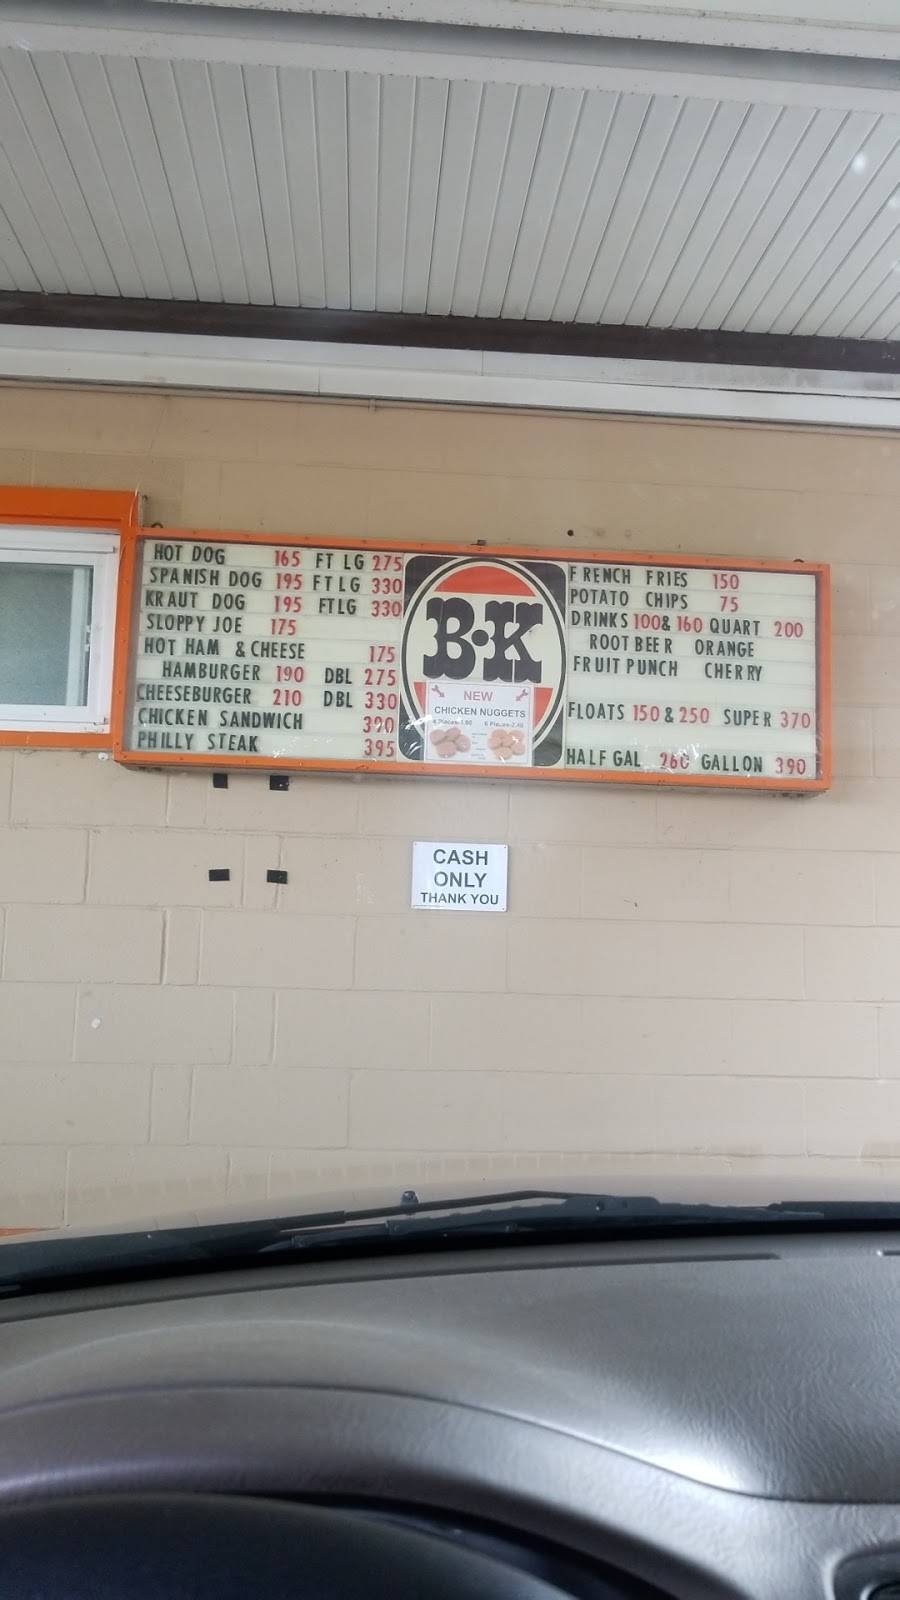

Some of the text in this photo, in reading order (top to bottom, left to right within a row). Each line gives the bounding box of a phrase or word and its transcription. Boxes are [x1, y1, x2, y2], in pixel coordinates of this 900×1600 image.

[154, 544, 182, 561] HOT
[192, 545, 225, 565] DOG
[275, 550, 301, 567] 165
[372, 555, 402, 572] 275
[150, 567, 220, 586] SPANISH
[229, 571, 262, 588] DOG
[276, 573, 302, 590] 195
[372, 578, 402, 594] 330
[570, 566, 740, 590] FRENCH FRIES 150
[145, 590, 198, 608] KRAUT
[212, 593, 245, 610] DOG
[274, 596, 302, 613] 195
[371, 600, 402, 617] 330
[570, 588, 739, 613] POTATO CHIPS 75
[146, 613, 296, 636] SLOPPY JOE 175
[571, 610, 628, 628] DRINKS
[709, 618, 761, 636] QUART
[773, 621, 804, 638] 200
[144, 637, 176, 656] HOT
[185, 638, 220, 656] HAM
[369, 646, 396, 663] 175
[695, 639, 755, 658] ORANGE
[162, 661, 396, 686] HAMBURGER 190 DBL 275
[705, 662, 763, 682] CHERRY
[137, 683, 397, 710] CHEESEBURGER 210 DBL 330
[464, 691, 493, 701] NEW
[138, 707, 208, 726] CHICKEN
[220, 710, 303, 730] SANDWICH
[434, 706, 526, 718] CHICKEN NUGGETS
[568, 701, 625, 720] FLOATS
[633, 704, 660, 722] 150
[724, 708, 772, 728] SUPER
[780, 710, 811, 729] 370
[138, 731, 395, 757] PHILLY STEAK 395
[567, 748, 607, 766] HALF
[613, 750, 641, 768] GAL
[701, 754, 763, 773] GALLON
[775, 757, 806, 775] 390
[433, 848, 488, 866] CASH
[434, 871, 488, 888] ONLY
[420, 892, 500, 905] THANK YOU
